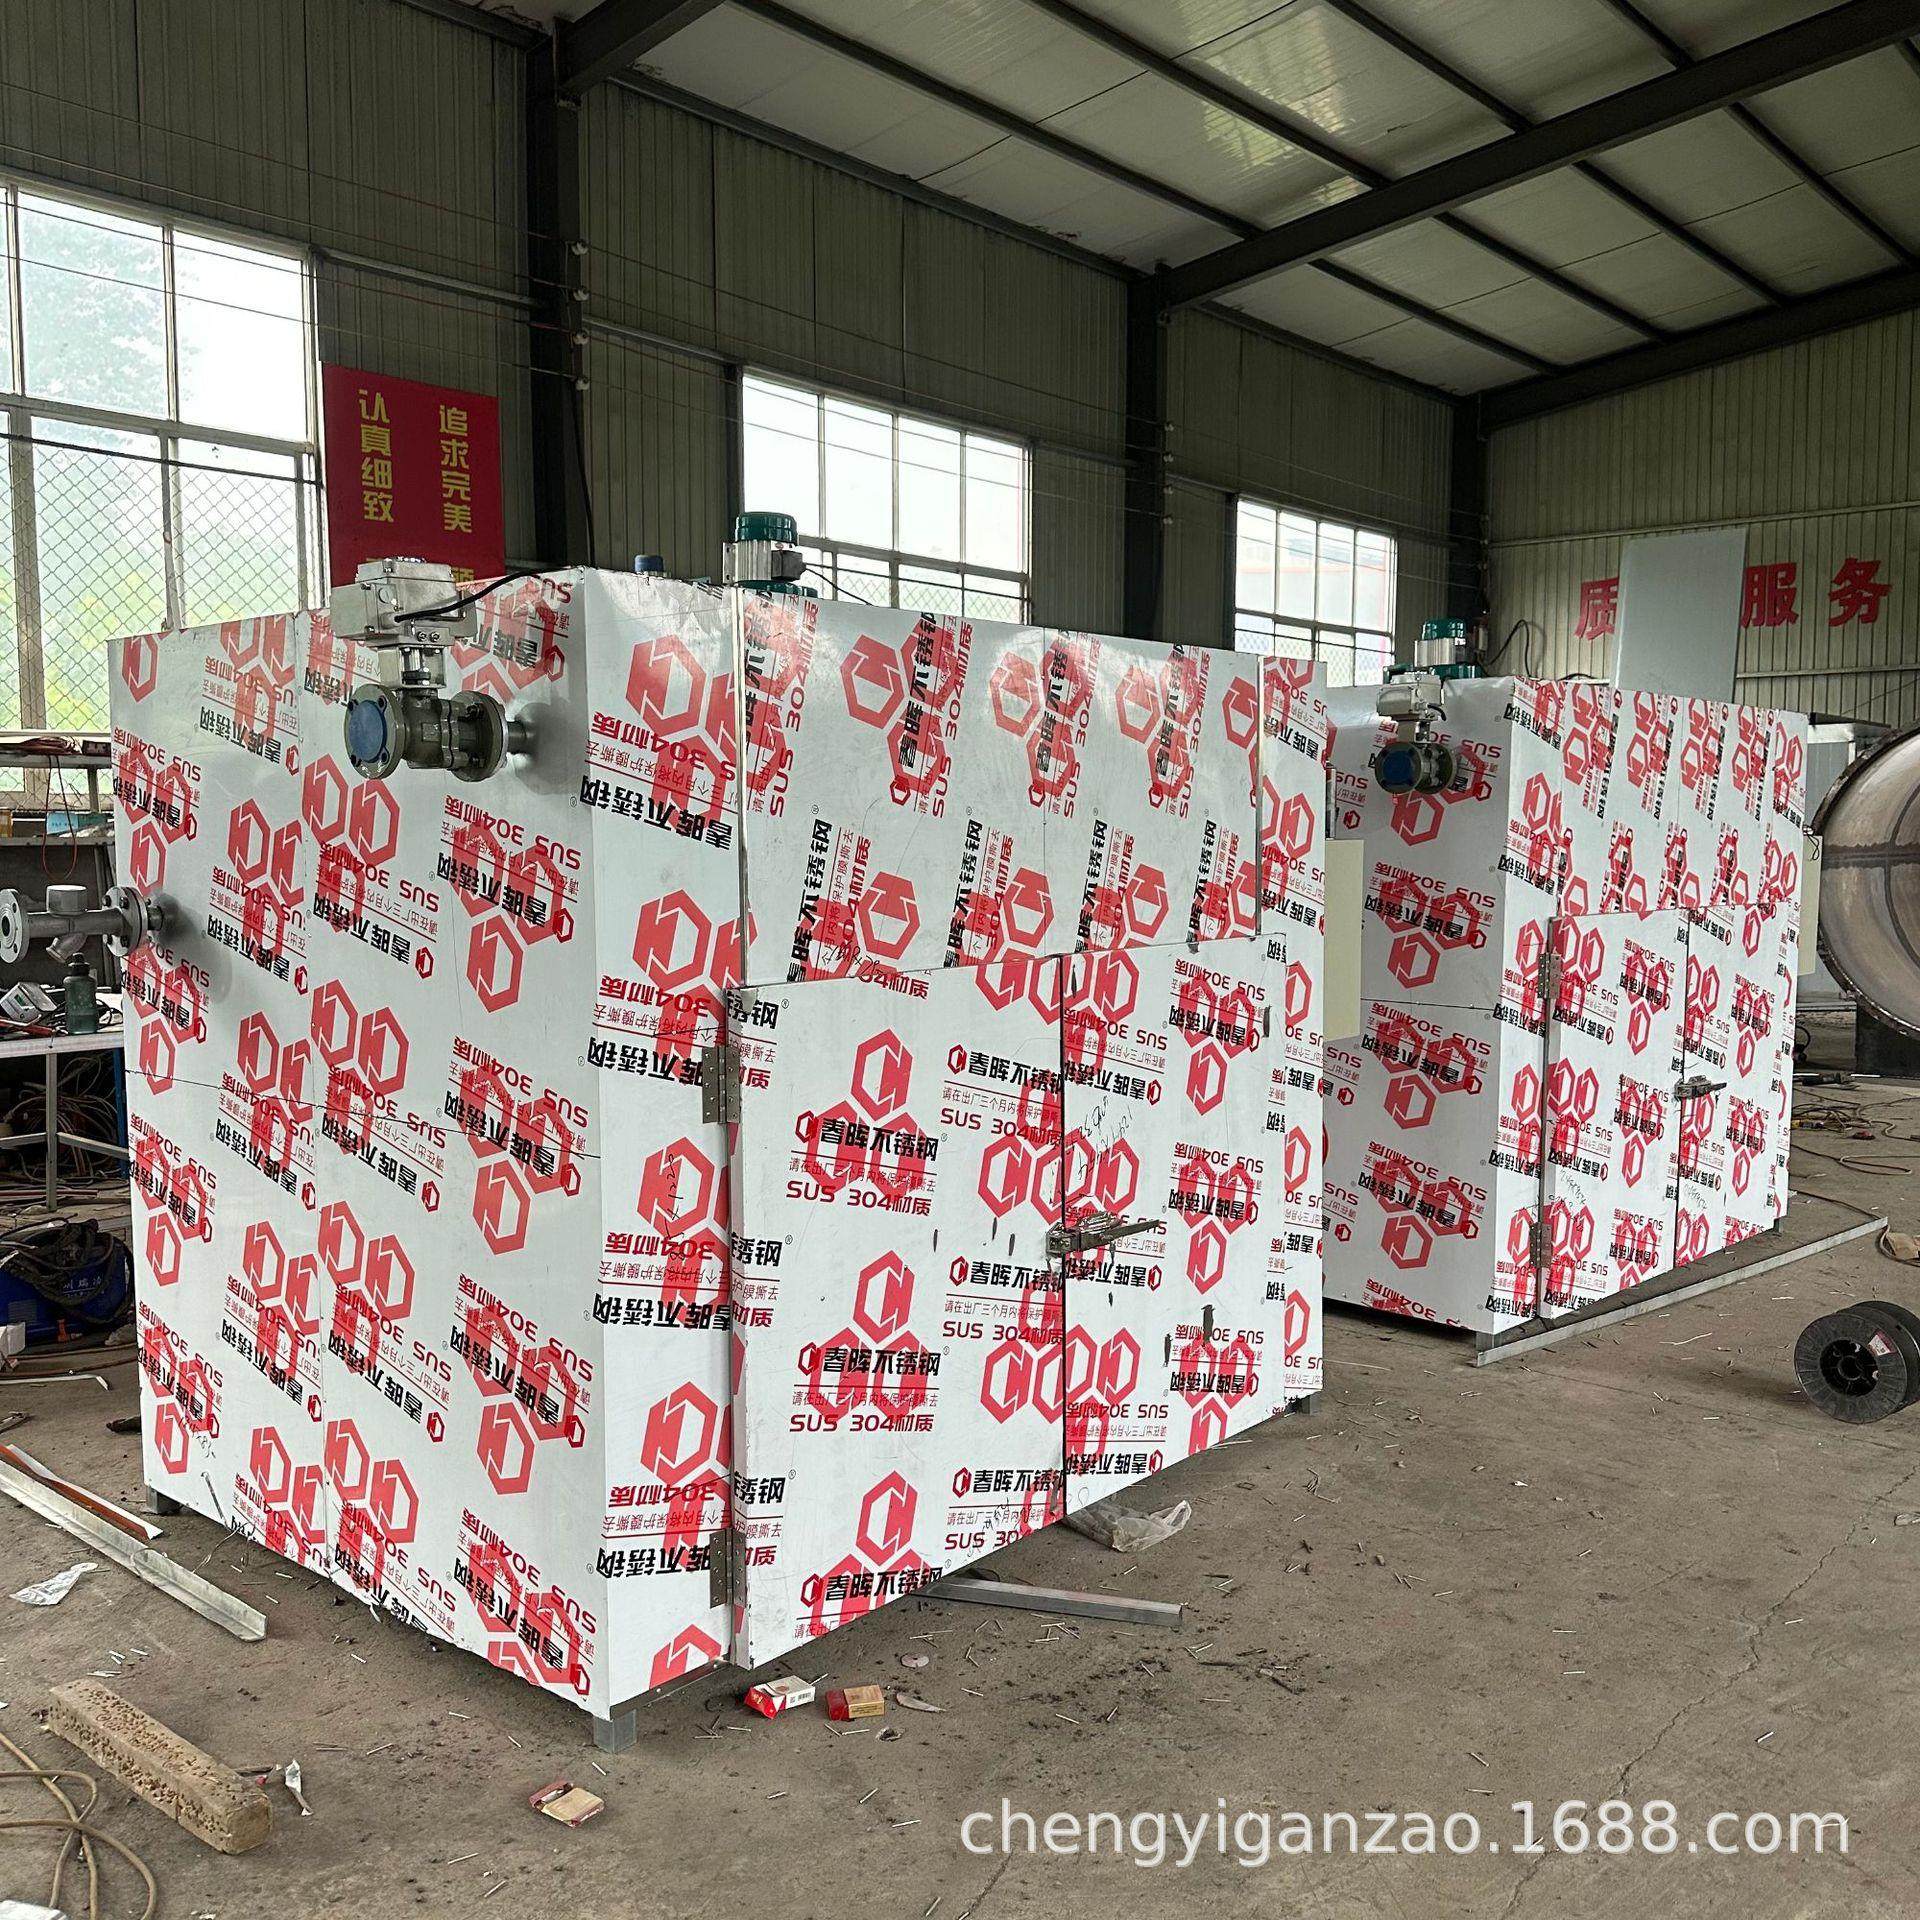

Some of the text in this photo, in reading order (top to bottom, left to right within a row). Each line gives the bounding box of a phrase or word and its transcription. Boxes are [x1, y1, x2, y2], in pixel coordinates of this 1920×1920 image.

[357, 388, 394, 523] 认真细致
[439, 403, 472, 533] 追求完美
[932, 756, 952, 819] SUS
[945, 620, 974, 741] 304材质
[591, 711, 706, 771] 304材质
[1460, 740, 1502, 758] SUS
[769, 749, 794, 818] SUS
[1063, 761, 1081, 820] SUS
[1180, 766, 1195, 820] SUS
[445, 795, 525, 847] 304材质
[580, 774, 732, 850] 春晖不锈钢
[534, 835, 581, 870] SUS
[400, 880, 440, 914] SUS
[437, 853, 546, 928] 春晖不锈钢
[986, 834, 1014, 950] 304材质
[1375, 862, 1446, 893] 304材质
[1456, 887, 1496, 907] SUS
[313, 892, 410, 965] 春晖不锈钢
[1365, 894, 1463, 939] 春晖不锈钢
[208, 914, 290, 982] 春晖不锈钢
[1660, 957, 1676, 973] SUS
[598, 975, 710, 1017] 304材质
[1175, 960, 1231, 991] 304材质
[1237, 981, 1266, 1002] SUS
[1601, 991, 1619, 1006] SUS
[1136, 1029, 1168, 1051] SUS
[1168, 1006, 1245, 1047] 春晖不锈钢
[1371, 1003, 1492, 1056] SUS 304材质
[453, 1035, 533, 1096] 304材质
[1326, 1046, 1362, 1068] SUS
[1362, 1034, 1460, 1084] 春晖不锈钢
[543, 1088, 588, 1129] SUS
[940, 1107, 1063, 1148] SUS 304材质
[407, 1112, 446, 1149] SUS
[444, 1090, 555, 1179] 春晖不锈钢
[821, 1118, 938, 1161] 春晖不锈钢
[1594, 1127, 1613, 1142] SUS
[215, 1118, 297, 1196] 春晖不锈钢
[322, 1113, 417, 1196] 春晖不锈钢
[1174, 1142, 1264, 1174] SUS 304材质
[1368, 1141, 1487, 1201] SUS 304材质
[786, 1180, 932, 1216] SUS 304材质
[1168, 1189, 1244, 1220] 春晖不锈钢
[1324, 1182, 1359, 1206] SUS
[1358, 1171, 1456, 1228] 春晖不锈钢
[1590, 1261, 1608, 1276] SUS
[459, 1272, 537, 1343] 304材质
[593, 1292, 731, 1331] 春晖不锈钢
[1366, 1278, 1437, 1321] 304材质
[943, 1321, 1063, 1345] SUS 304材质
[1237, 1330, 1264, 1345] SUS
[328, 1330, 423, 1423] 春晖不锈钢
[413, 1340, 452, 1382] SUS
[450, 1325, 560, 1427] 春晖不锈钢
[548, 1337, 594, 1382] SUS
[824, 1346, 940, 1376] 春晖不锈钢
[1170, 1372, 1245, 1395] 春晖不锈钢
[789, 1413, 934, 1433] SUS 304材质
[1137, 1404, 1169, 1419] SUS
[608, 1482, 718, 1508] 304材质
[461, 1506, 541, 1587] 304材质
[944, 1531, 985, 1550] SUS
[417, 1567, 456, 1612] SUS
[551, 1585, 596, 1635] SUS
[453, 1558, 563, 1673] 春晖不锈钢
